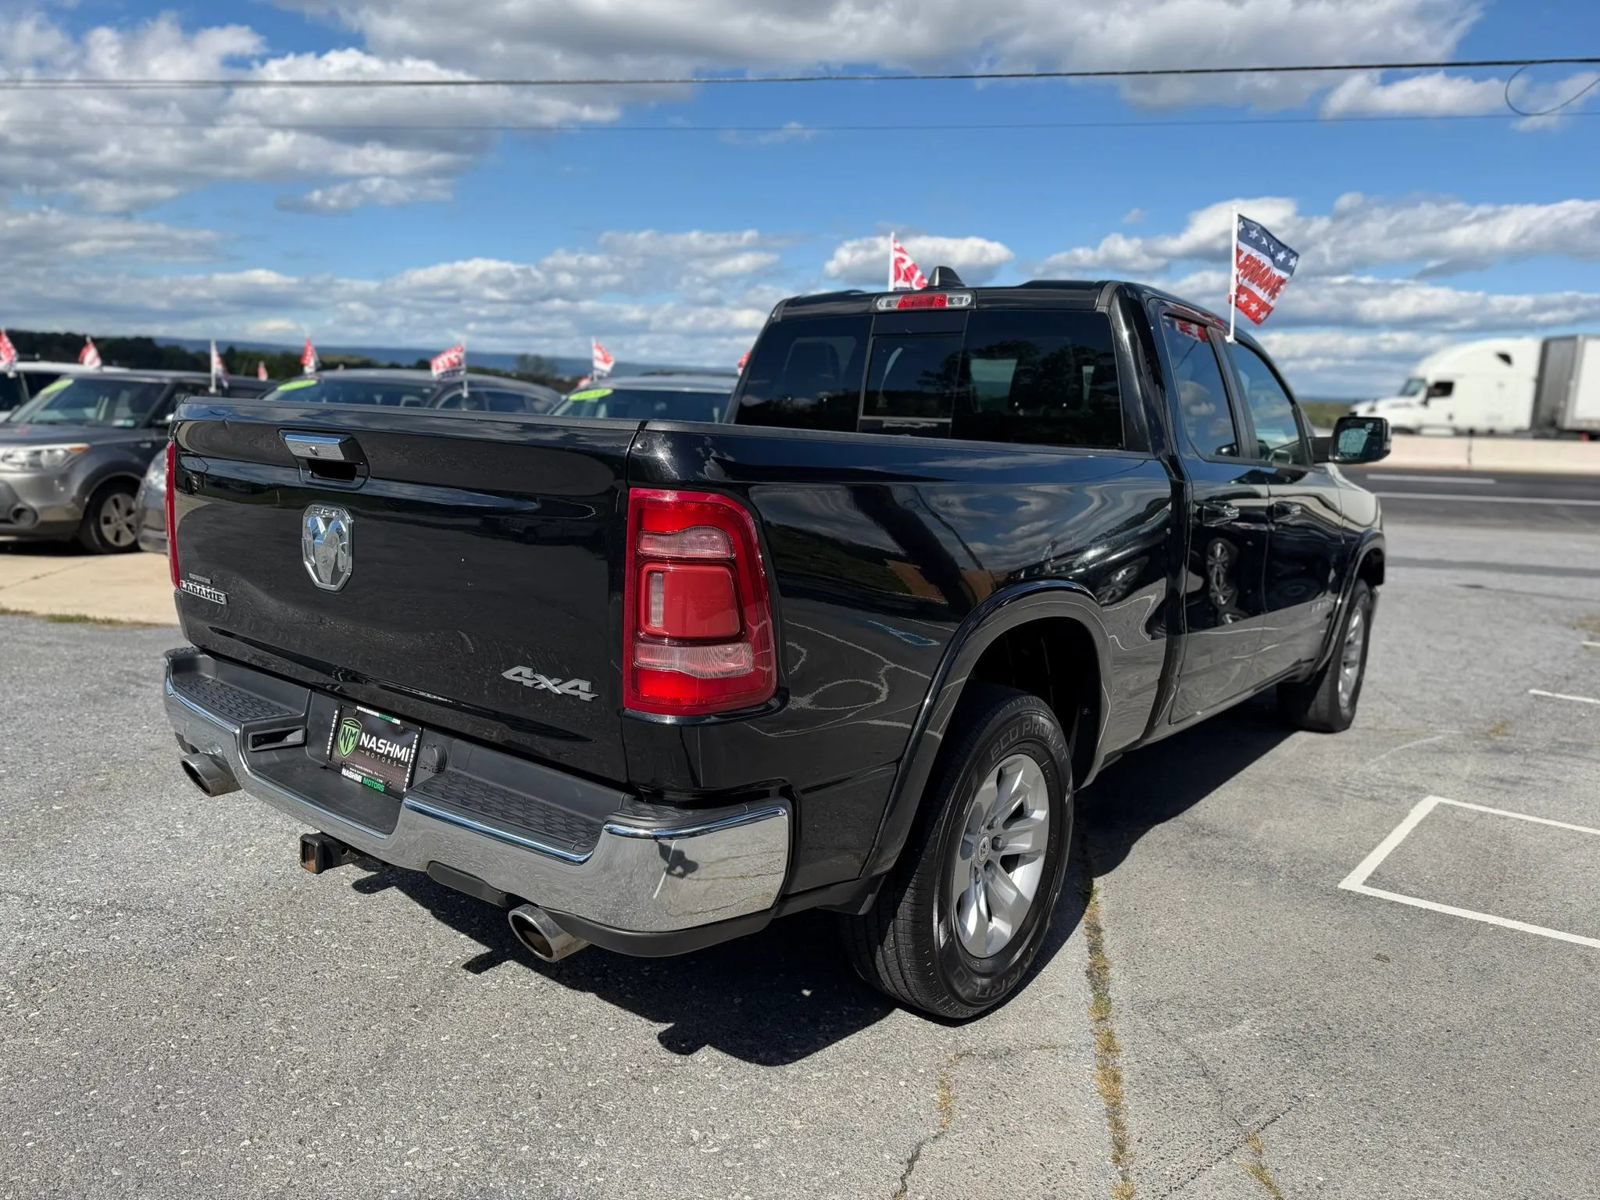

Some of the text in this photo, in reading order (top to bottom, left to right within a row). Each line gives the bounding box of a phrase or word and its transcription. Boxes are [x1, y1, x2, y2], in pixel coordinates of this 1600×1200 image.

[359, 732, 410, 762] NASHMI
[365, 751, 397, 767] MOTORS
[341, 766, 363, 784] NASHMI
[362, 776, 385, 792] MOTORS
